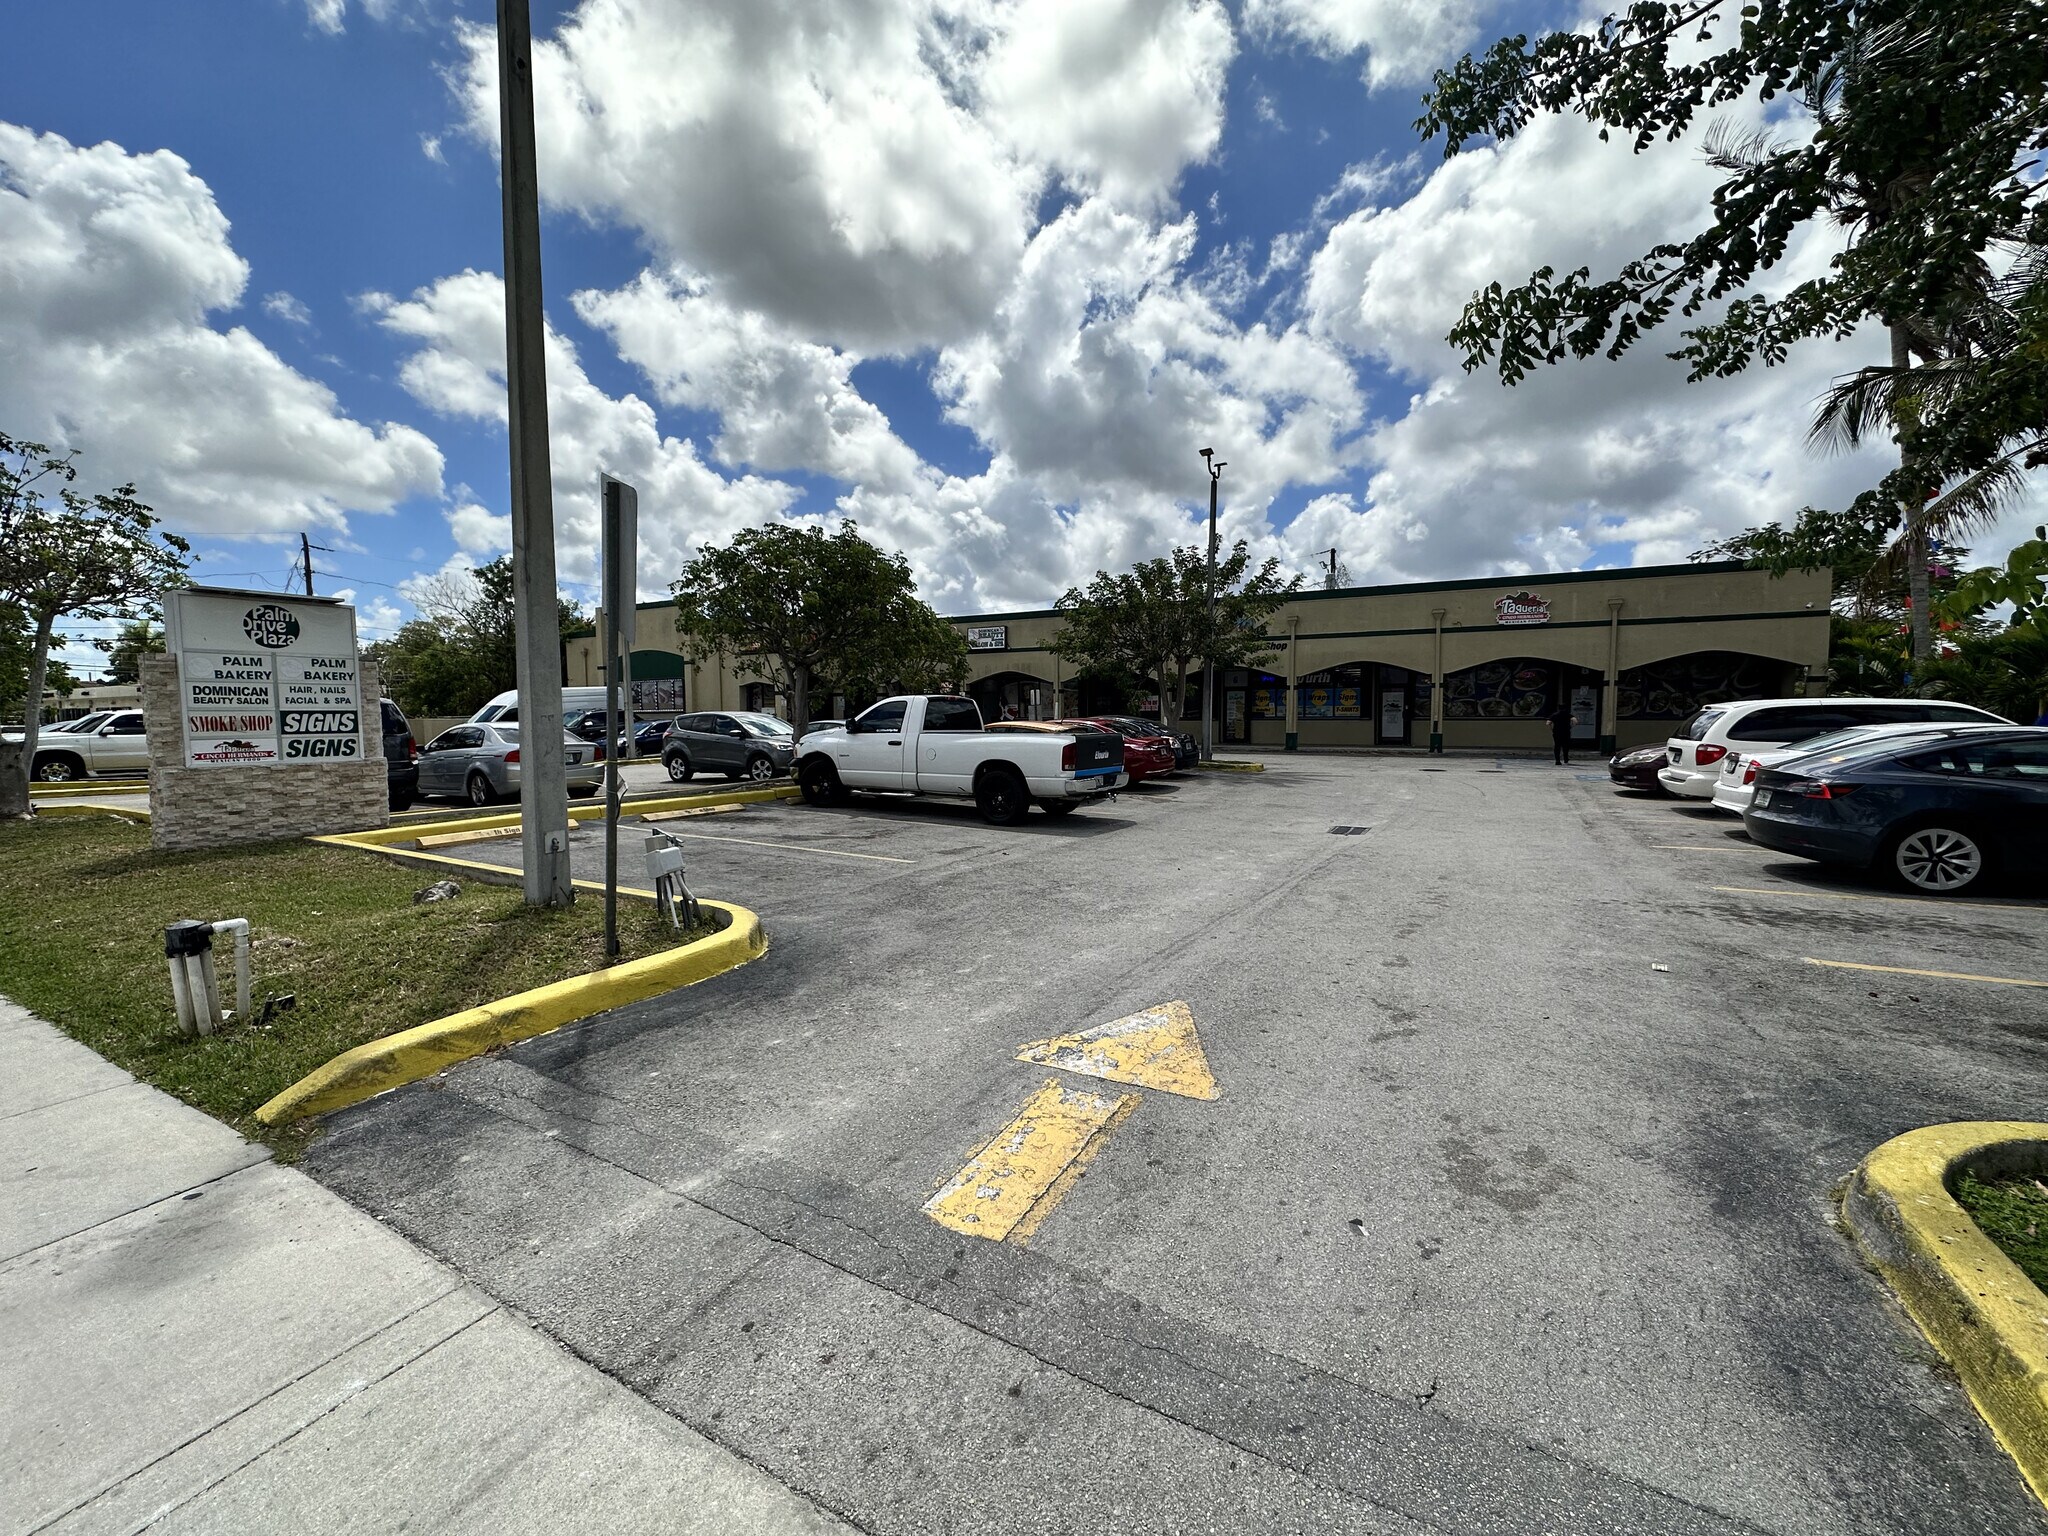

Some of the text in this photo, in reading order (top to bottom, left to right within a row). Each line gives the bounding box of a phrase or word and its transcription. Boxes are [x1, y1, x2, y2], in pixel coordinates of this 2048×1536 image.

[1502, 600, 1544, 613] Taqueria
[252, 606, 295, 622] Palm
[243, 616, 287, 632] Drive
[251, 630, 296, 645] Plaza
[222, 656, 263, 667] PALM
[311, 658, 346, 668] PALM
[214, 670, 272, 680] BAKERY
[303, 671, 354, 681] BAKERY
[192, 685, 269, 697] DOMINICAN
[320, 686, 346, 694] NAILS
[193, 696, 269, 705] BEAUTY SALON
[190, 715, 273, 732] SMOKE SHOP
[283, 713, 355, 732] SIGNS
[285, 738, 357, 758] SIGNS
[227, 751, 269, 759] HERMANOS
